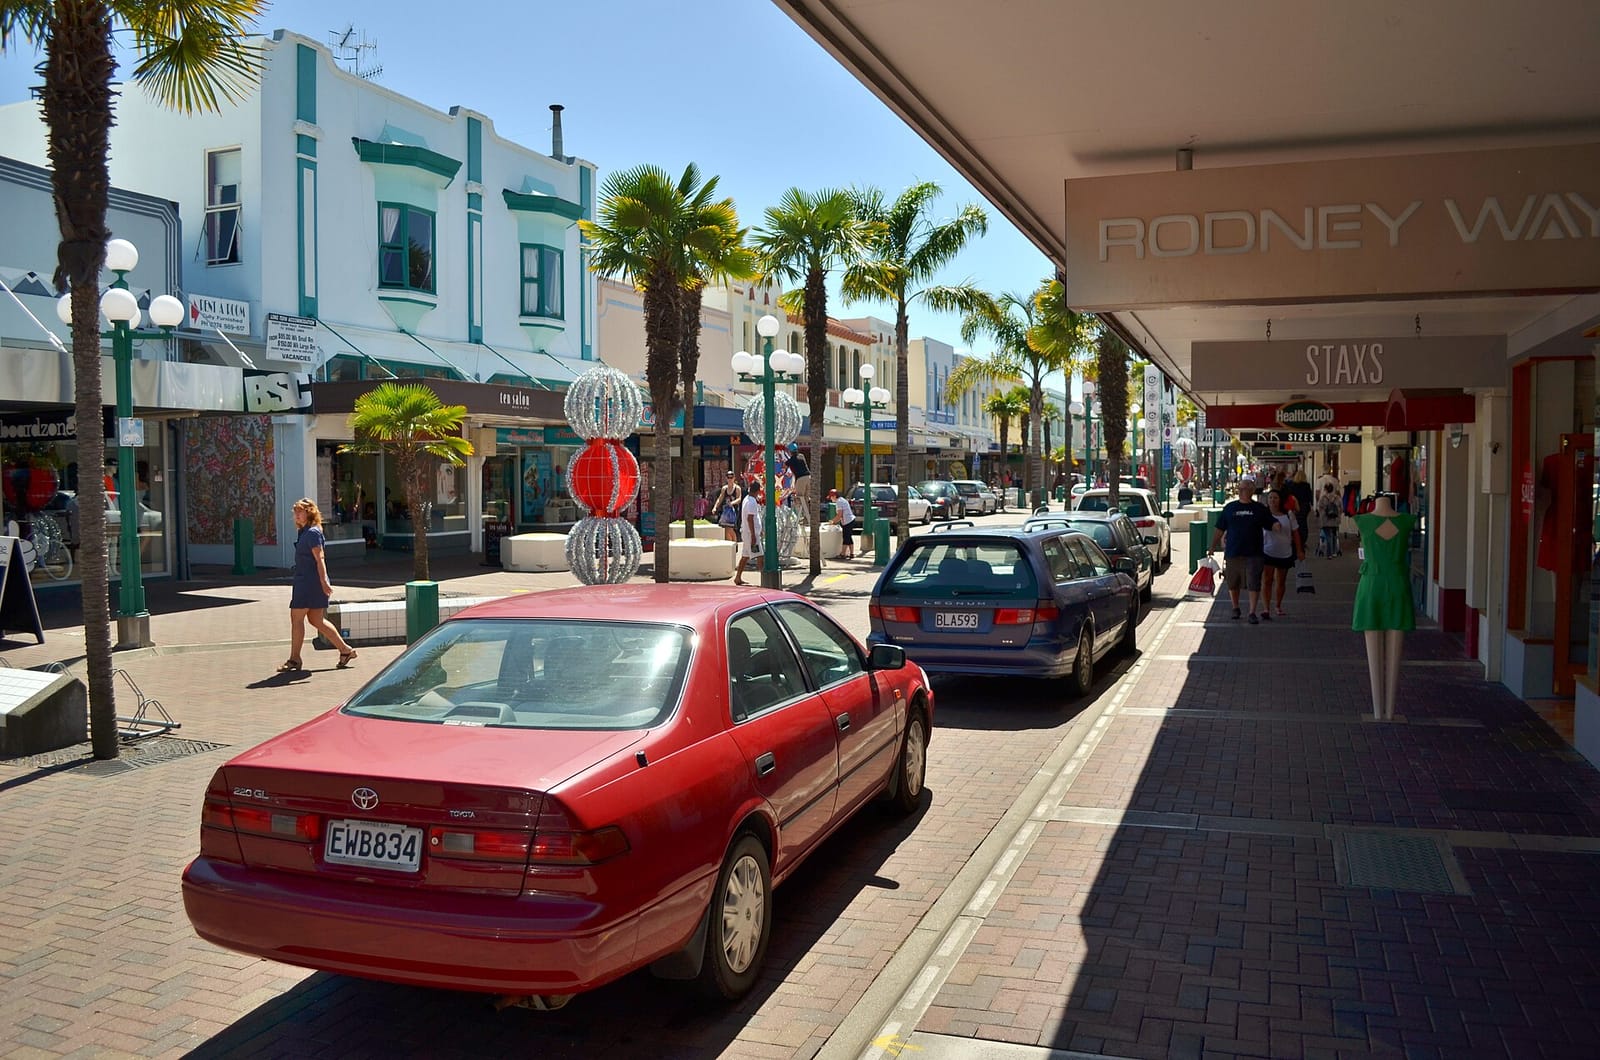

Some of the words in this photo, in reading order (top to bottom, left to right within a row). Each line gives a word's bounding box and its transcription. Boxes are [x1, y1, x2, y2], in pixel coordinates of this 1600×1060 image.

[1098, 202, 1423, 263] RODNEY
[220, 303, 225, 315] A
[281, 353, 311, 361] VACANCIES
[1306, 344, 1384, 384] STAXS
[512, 390, 530, 406] salon
[1276, 408, 1334, 422] Health2000
[1288, 433, 1315, 441] SIZES
[1320, 434, 1350, 442] 10-26
[936, 614, 978, 627] BLA593
[449, 810, 476, 818] TOYOTA
[330, 827, 417, 862] EWB834
